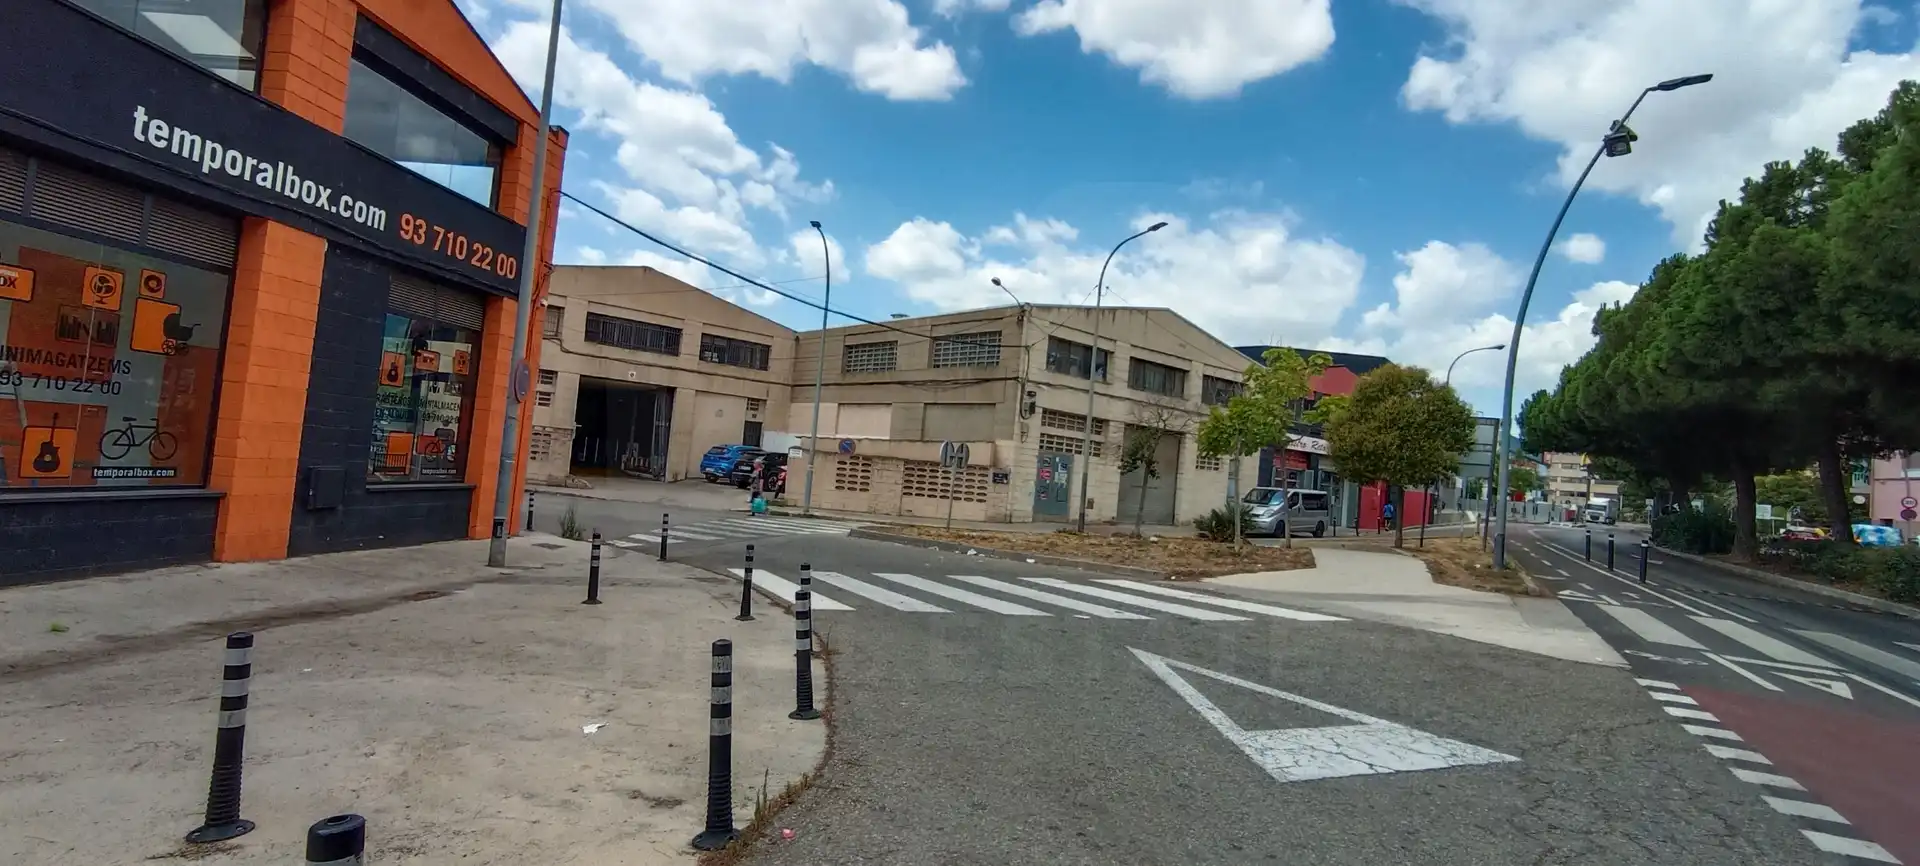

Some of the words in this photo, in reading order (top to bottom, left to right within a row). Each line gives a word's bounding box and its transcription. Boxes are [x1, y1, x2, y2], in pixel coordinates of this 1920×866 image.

[133, 105, 386, 231] temporalbox.com
[400, 213, 427, 245] 93
[433, 225, 468, 260] 710
[471, 242, 493, 271] 22
[496, 253, 517, 279] 00
[0, 370, 23, 387] 93
[32, 373, 66, 391] 710
[72, 379, 93, 393] 22
[101, 381, 122, 396] 00
[93, 468, 175, 478] temporalbox.com
